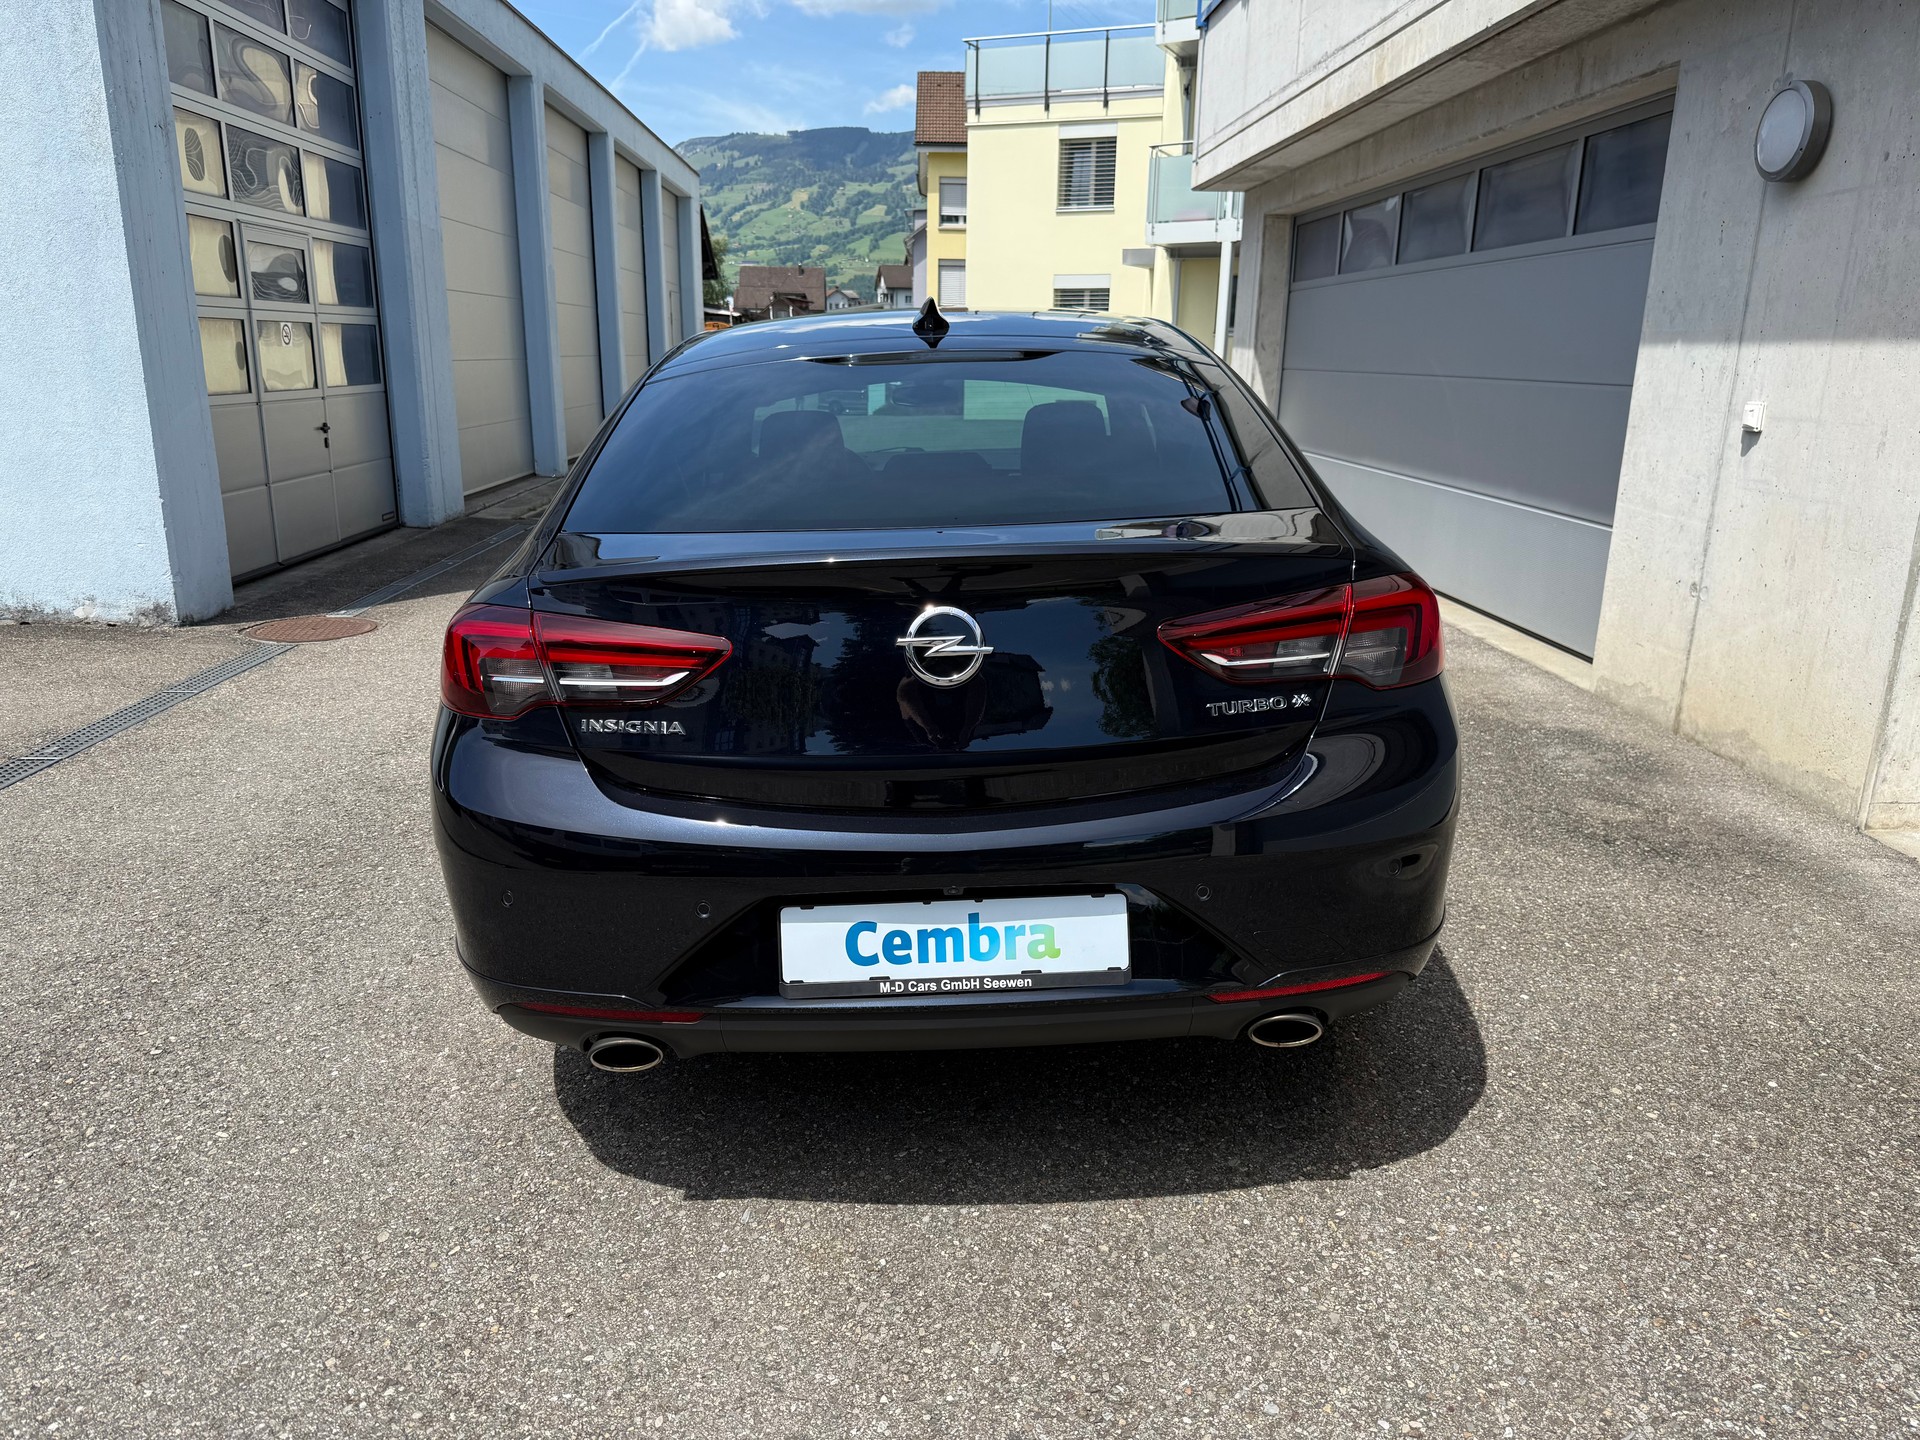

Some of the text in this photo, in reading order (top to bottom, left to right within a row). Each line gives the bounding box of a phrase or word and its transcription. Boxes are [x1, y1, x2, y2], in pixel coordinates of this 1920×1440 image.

[1206, 696, 1287, 716] TURBO
[581, 719, 686, 735] INSIGNIA
[845, 912, 1061, 967] Cembra
[880, 977, 1032, 993] M-D Cars GmbH Seewen
